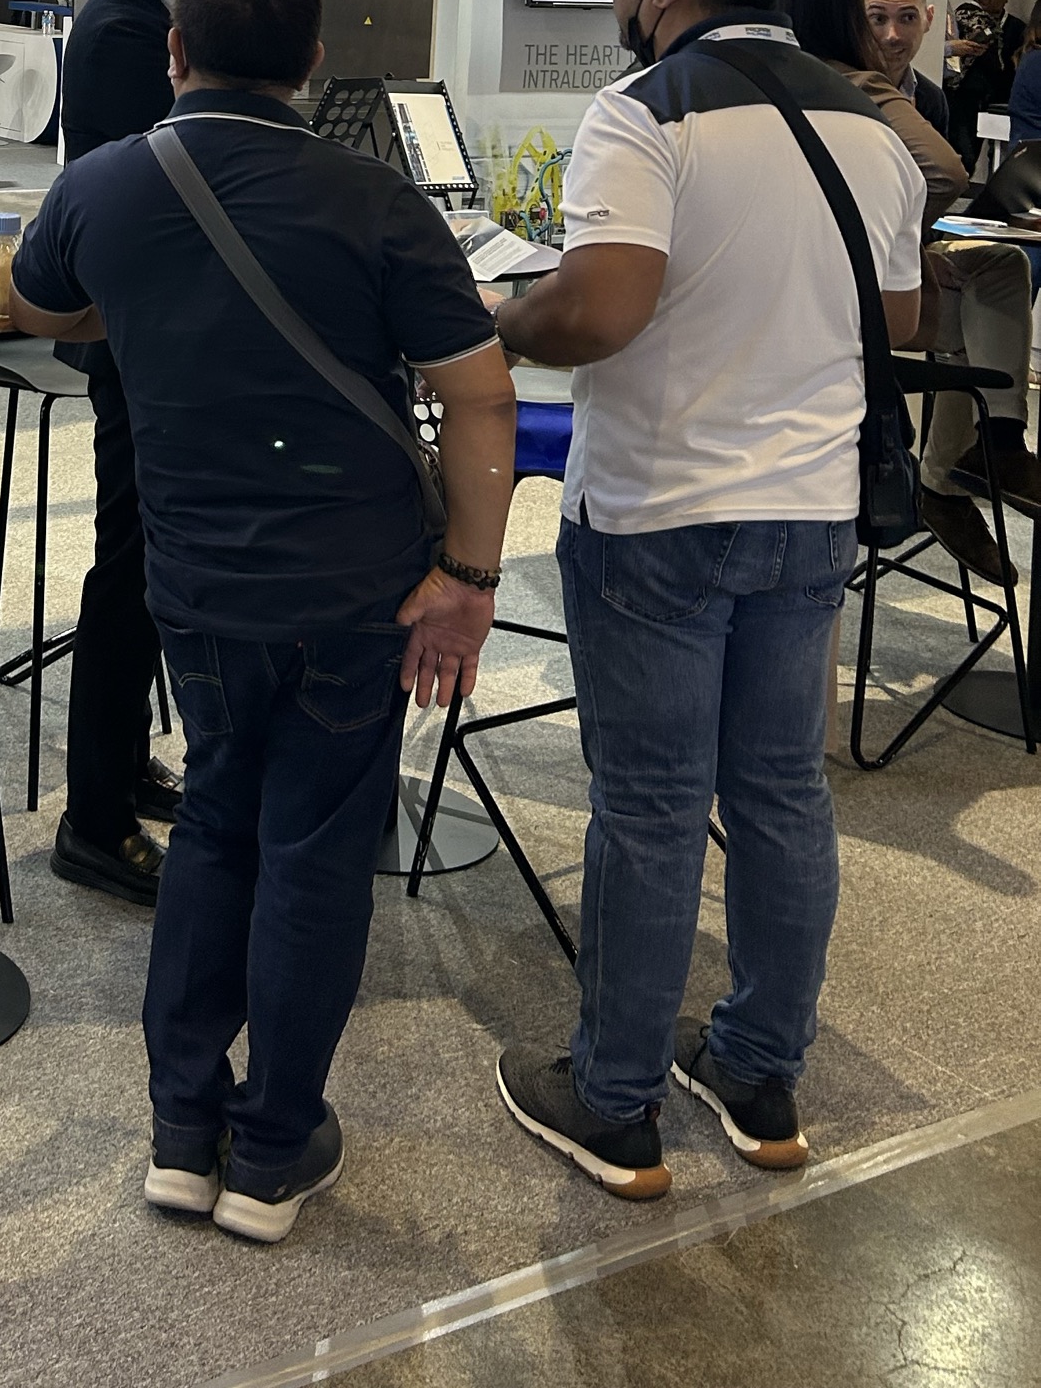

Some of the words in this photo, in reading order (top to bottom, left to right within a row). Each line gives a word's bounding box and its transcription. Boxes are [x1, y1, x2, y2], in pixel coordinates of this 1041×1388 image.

[524, 44, 559, 66] THE
[566, 44, 621, 66] HEART
[522, 69, 623, 89] INTRALOGIS
